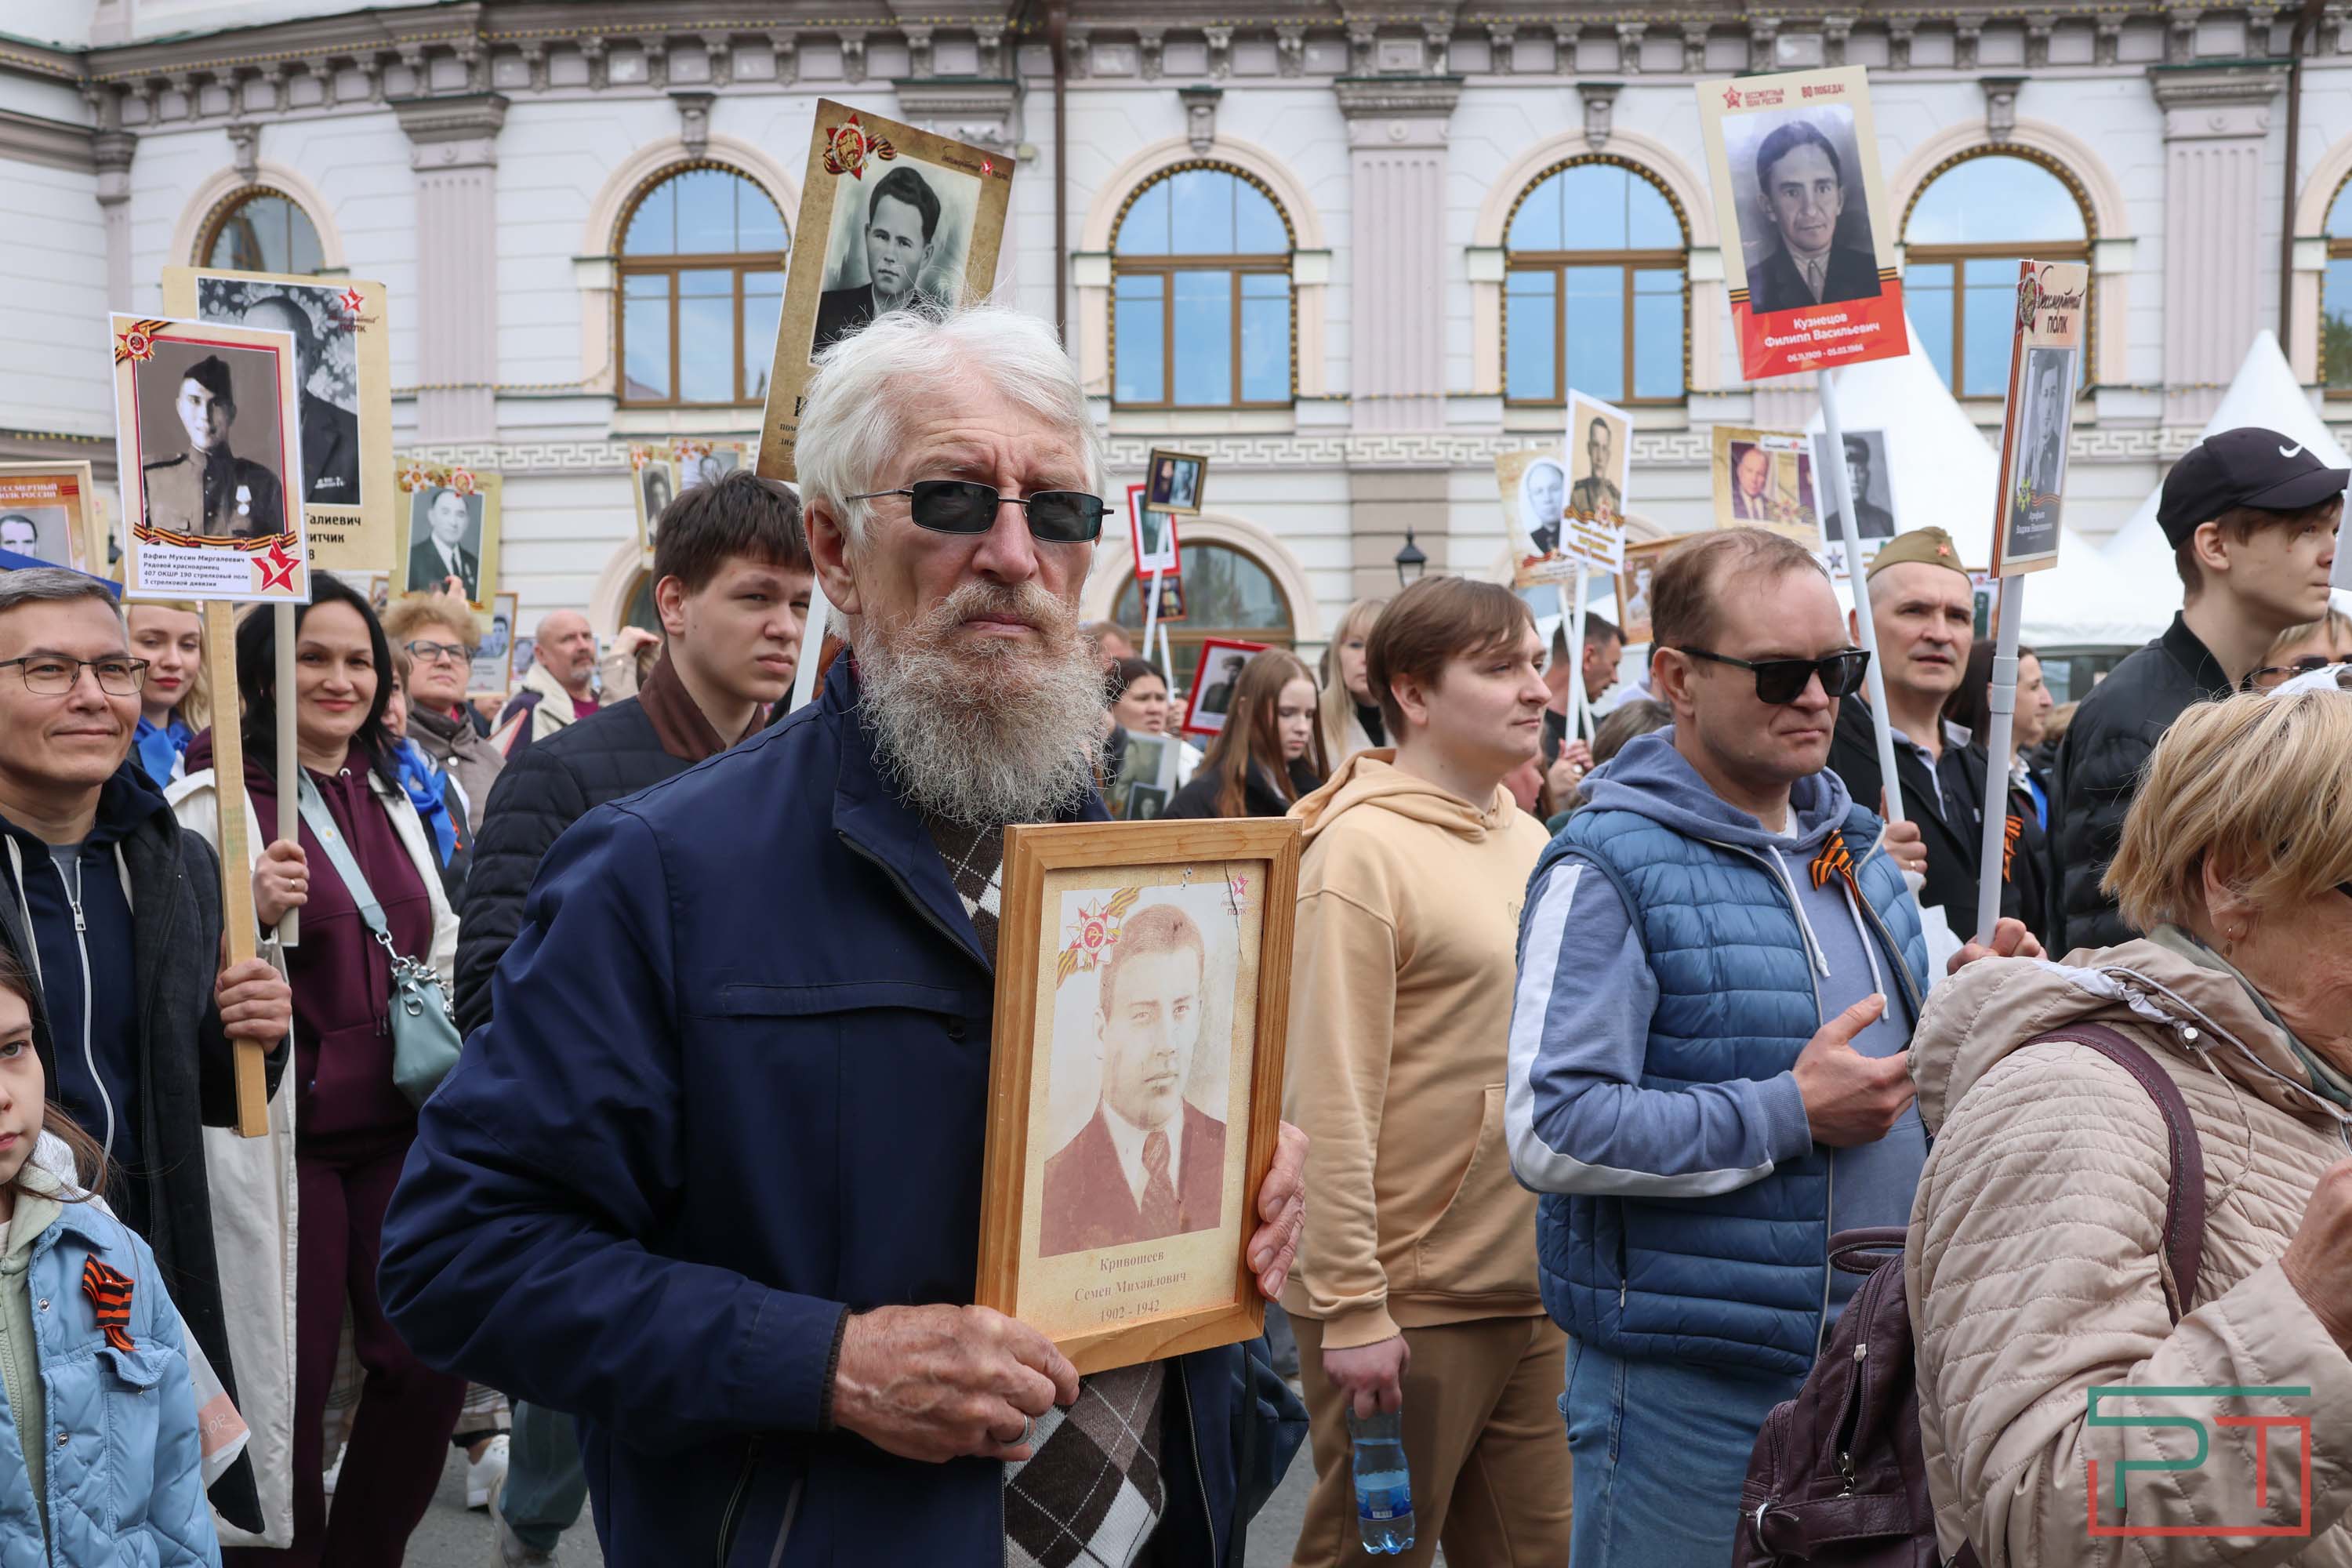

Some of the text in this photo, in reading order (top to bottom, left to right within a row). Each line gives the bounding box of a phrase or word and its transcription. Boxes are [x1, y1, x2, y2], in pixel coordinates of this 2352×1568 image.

[1793, 314, 1848, 330] Кузнецов
[2047, 315, 2068, 333] ПОЛК
[1765, 322, 1880, 347] Филипп Васильевич
[306, 513, 361, 526] алиевич
[307, 533, 345, 543] итчик
[1075, 1272, 1186, 1301] Семен Михайлович
[1099, 1306, 1125, 1323] 1902
[1136, 1299, 1160, 1316] 1942
